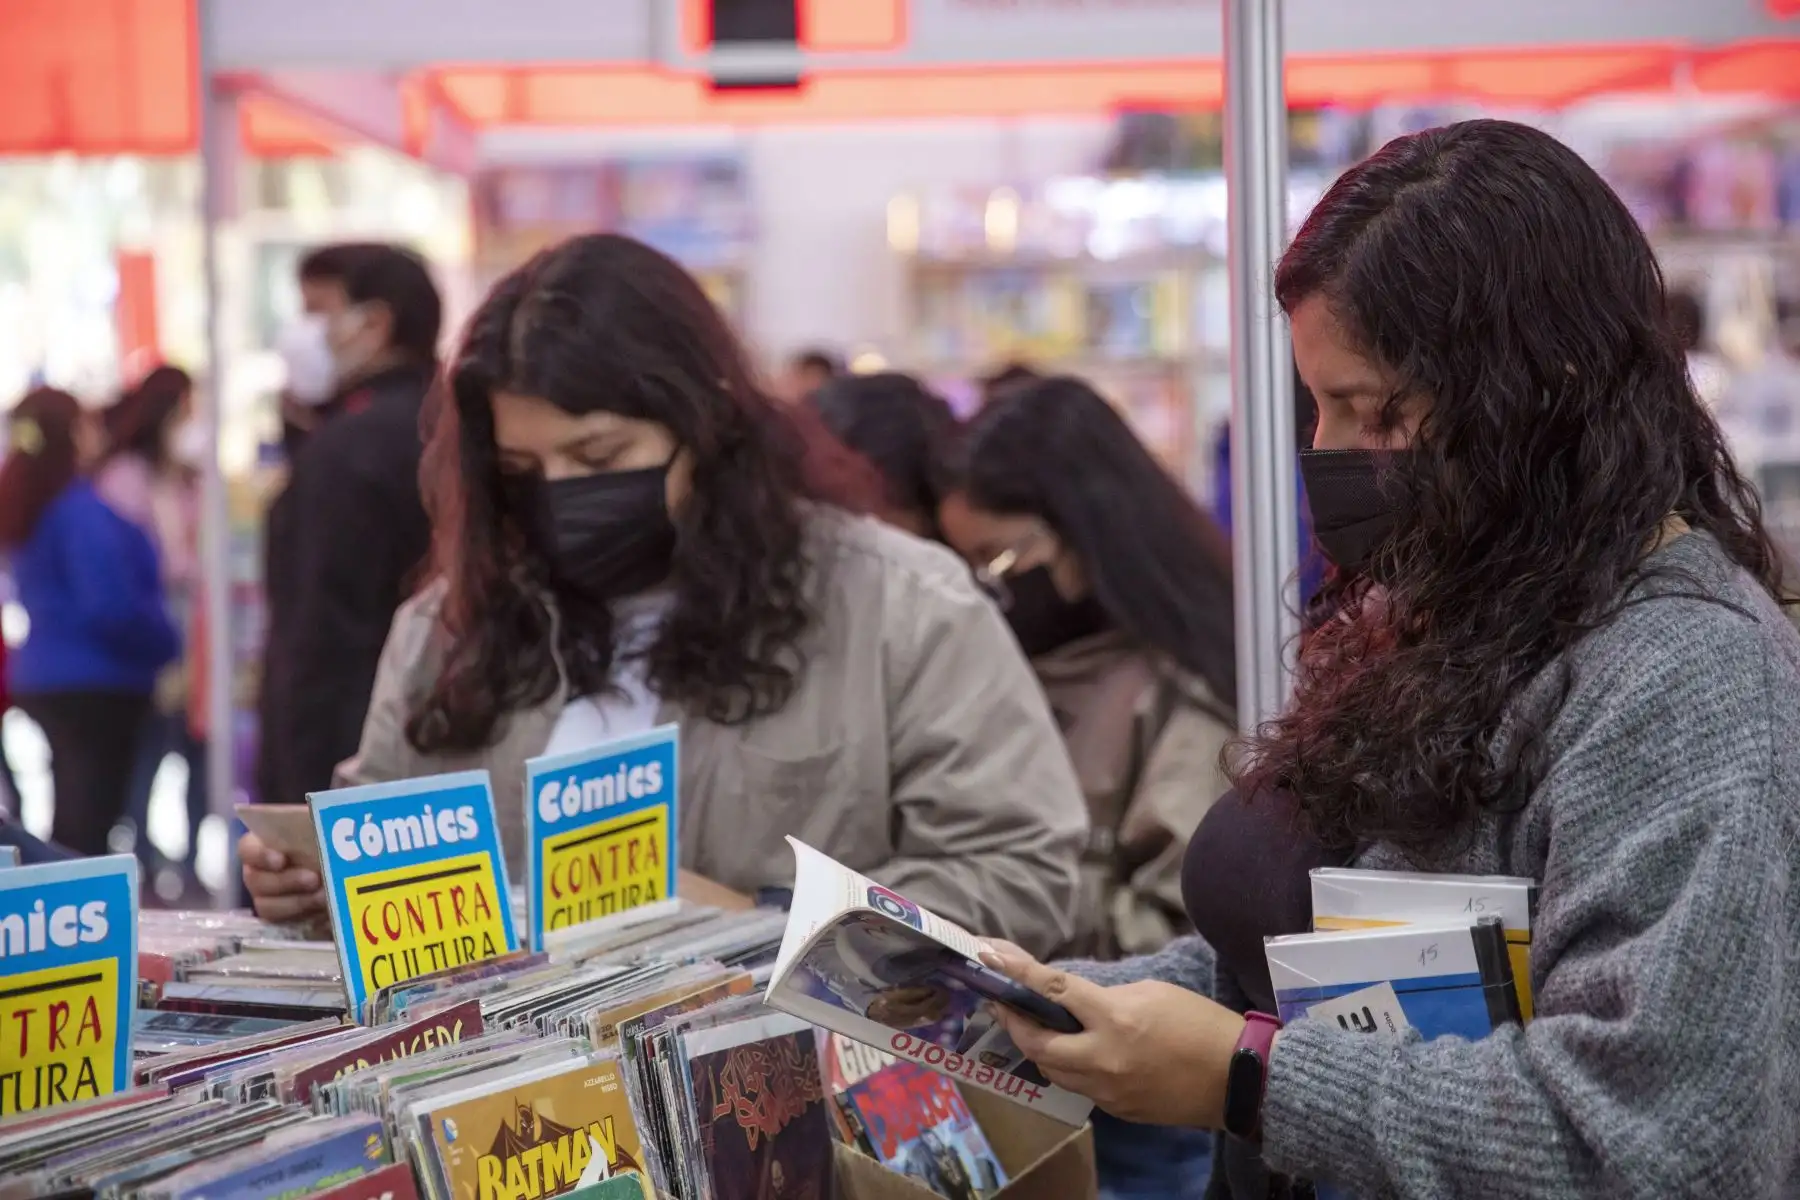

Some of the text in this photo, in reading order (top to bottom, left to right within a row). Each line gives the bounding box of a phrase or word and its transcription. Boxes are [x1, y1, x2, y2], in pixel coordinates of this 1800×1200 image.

[538, 760, 664, 823] Cómics
[331, 804, 479, 861] Cómics
[550, 833, 660, 899] CONTRA
[361, 882, 492, 945] CONTRA
[0, 995, 102, 1058] TRA
[478, 1114, 618, 1200] BATMAN
